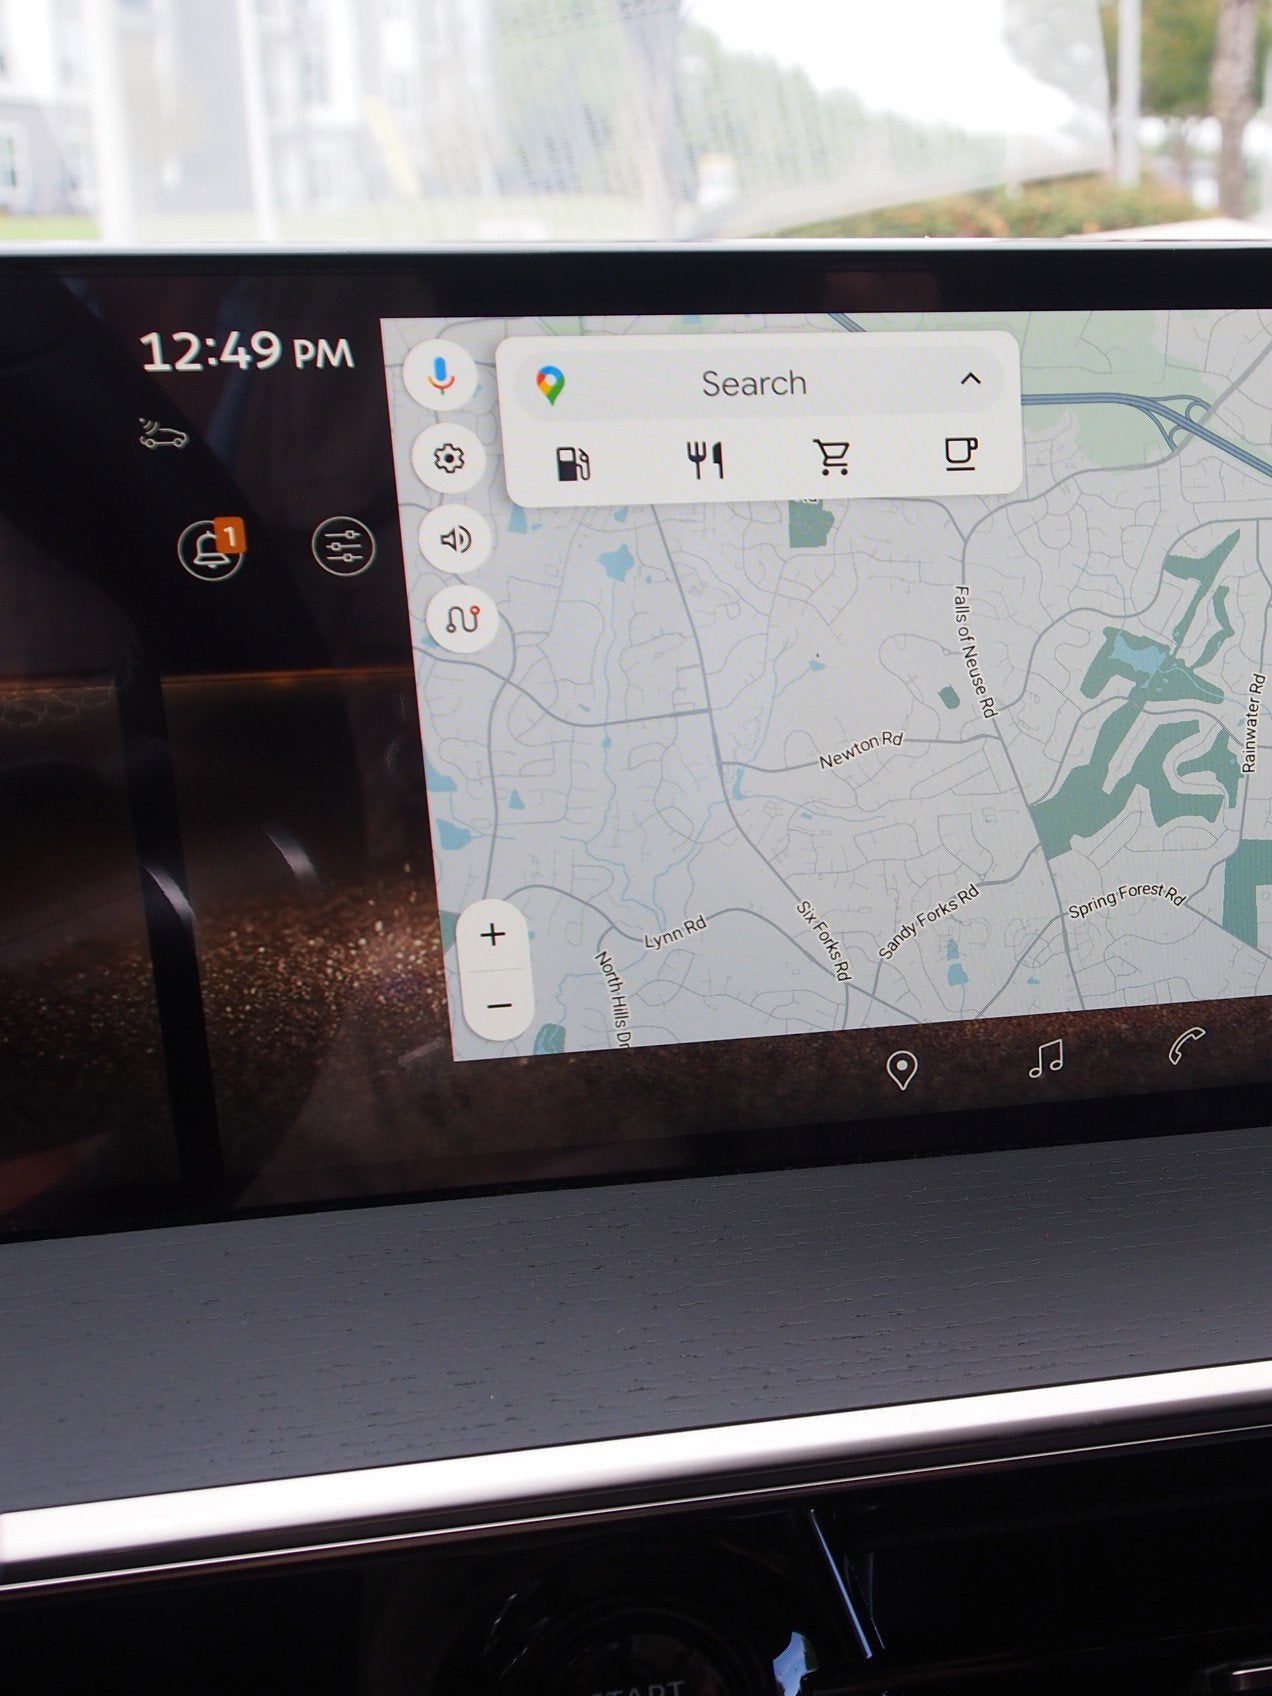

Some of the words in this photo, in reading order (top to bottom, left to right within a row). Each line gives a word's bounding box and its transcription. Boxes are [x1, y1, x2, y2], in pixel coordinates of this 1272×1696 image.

[140, 330, 282, 372] 12:49
[294, 338, 355, 370] PM
[702, 369, 807, 398] Search
[223, 526, 237, 547] 1
[955, 585, 969, 623] Falls
[957, 626, 973, 643] of
[962, 645, 987, 695] Neuse
[1249, 673, 1266, 694] Rd
[979, 697, 998, 718] Rd
[819, 736, 879, 769] Newton
[881, 731, 904, 748] Rd
[1242, 695, 1260, 773] Rainwater
[1068, 888, 1118, 919] Spring
[1118, 883, 1164, 899] Forest
[1164, 886, 1188, 907] Rd
[644, 928, 683, 950] Lynn
[684, 916, 708, 934] Rd
[879, 924, 920, 960] Sandy
[916, 899, 961, 930] Forks
[958, 884, 981, 907] Rd
[797, 900, 817, 925] Six
[812, 921, 842, 961] Forks
[835, 961, 852, 983] Rd
[595, 950, 624, 993] North
[611, 995, 630, 1028] Hills
